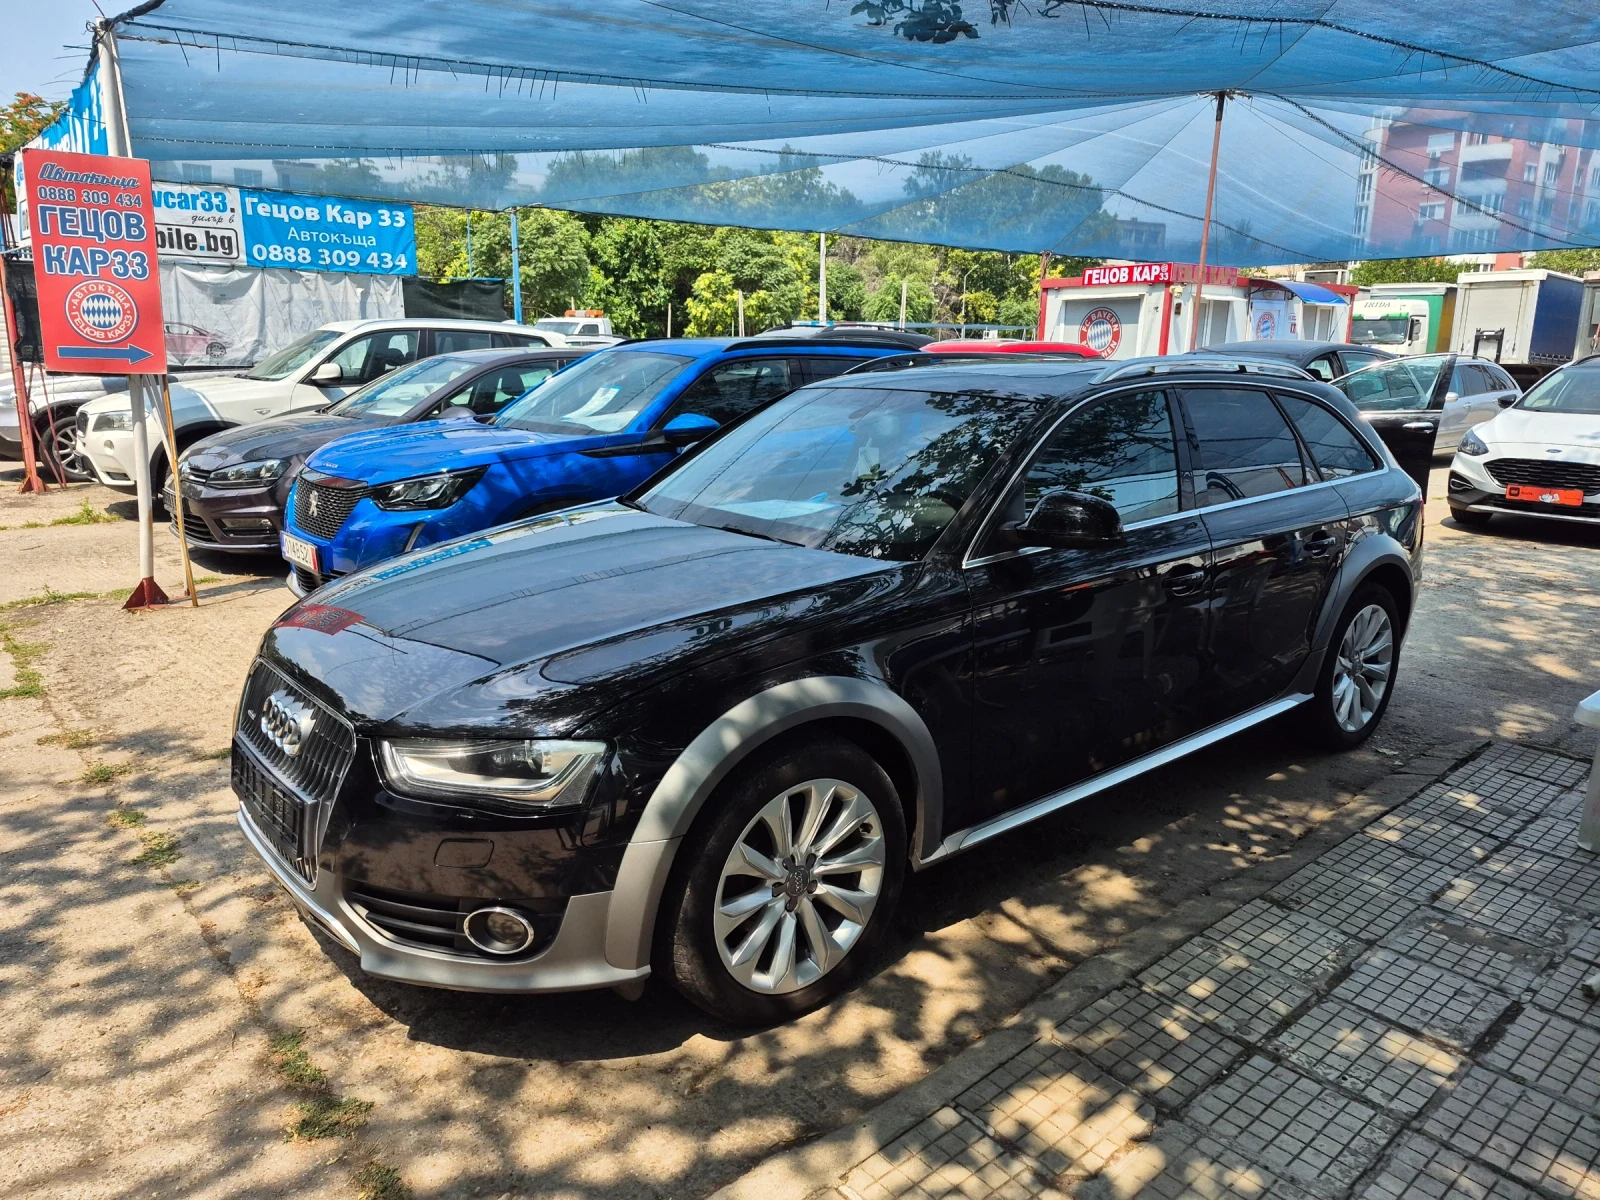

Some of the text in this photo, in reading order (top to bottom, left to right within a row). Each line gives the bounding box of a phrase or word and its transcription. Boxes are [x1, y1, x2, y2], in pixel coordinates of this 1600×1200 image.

[38, 162, 140, 189] Автокъща
[38, 186, 142, 208] 0888 309 434
[38, 204, 147, 242] ГЕЦОВ
[245, 197, 405, 229] Гецов Кар 33
[288, 227, 376, 248] Автокъща
[42, 245, 149, 280] КАР33
[252, 244, 407, 268] 0888 309 434
[1084, 265, 1160, 285] ГЕЦОВ КАР
[1159, 272, 1169, 281] 33
[72, 284, 130, 309] АВТОКЪЩА
[71, 312, 105, 338] ГЕЦОВ
[1091, 311, 1119, 331] BAYERN
